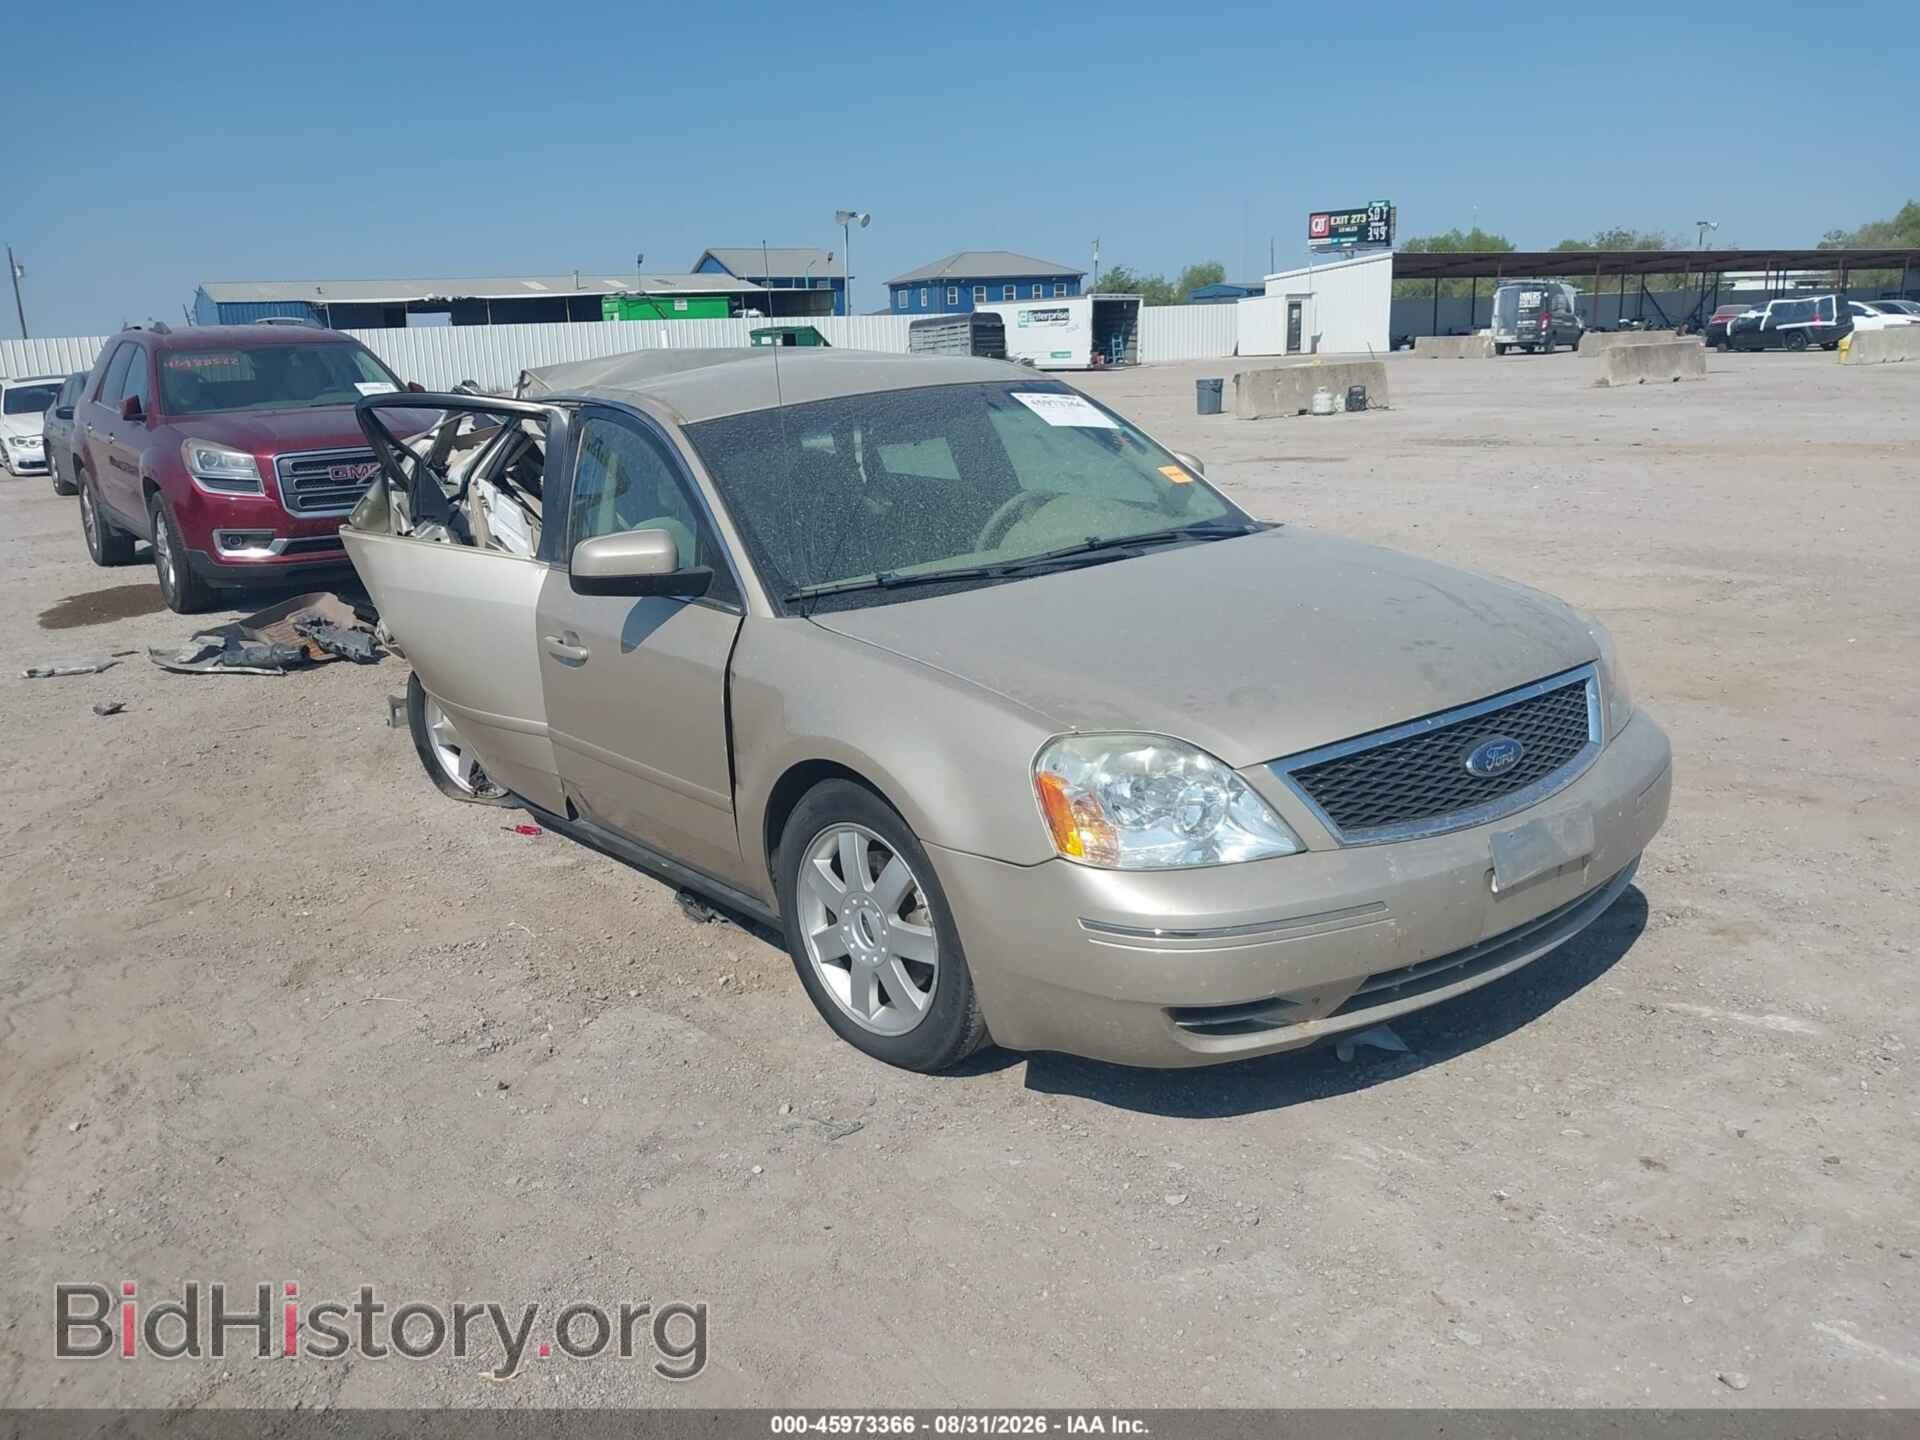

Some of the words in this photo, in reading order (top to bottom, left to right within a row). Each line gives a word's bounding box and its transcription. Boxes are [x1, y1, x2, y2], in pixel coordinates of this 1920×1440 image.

[1312, 217, 1327, 233] QT
[1330, 215, 1348, 225] EXIT
[1350, 213, 1367, 224] 273
[1028, 309, 1069, 321] Enterprise
[1486, 745, 1514, 771] Ford
